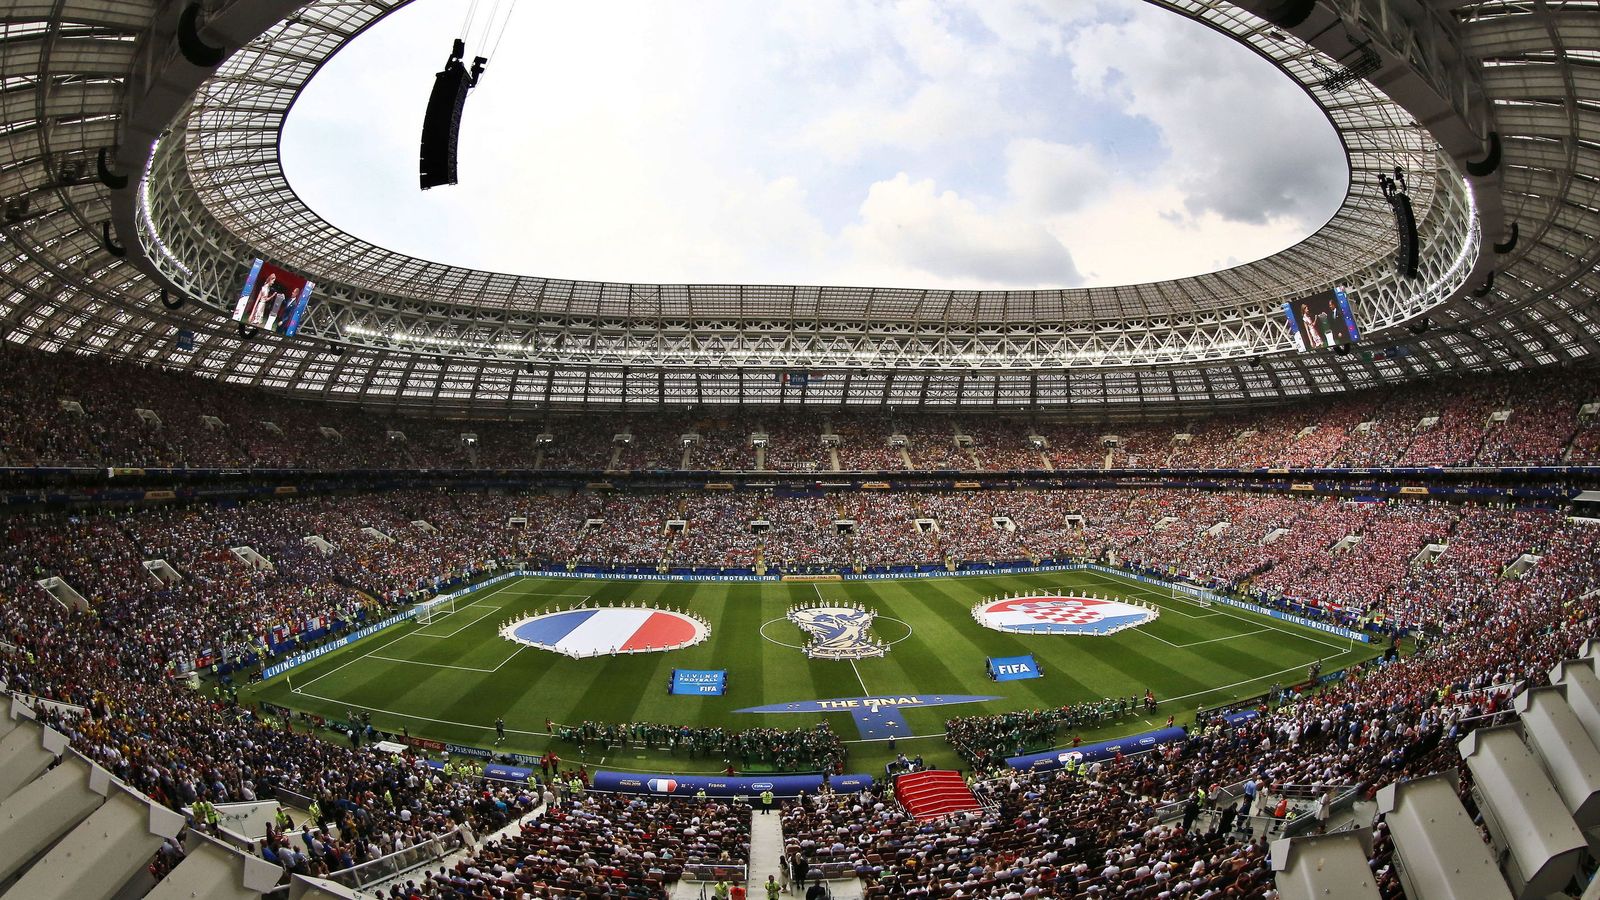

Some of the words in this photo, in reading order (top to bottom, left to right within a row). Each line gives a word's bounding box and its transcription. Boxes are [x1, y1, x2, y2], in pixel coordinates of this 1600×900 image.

[1091, 564, 1106, 572] LIVING
[1106, 566, 1129, 578] FOOTBALL
[476, 582, 488, 590] LIVING
[490, 574, 507, 584] FOOTBALL
[1144, 577, 1160, 586] LIVING
[1162, 581, 1188, 593] FOOTBALL
[1206, 593, 1224, 604] LIVING
[1227, 598, 1256, 611] FOOTBALL
[357, 623, 378, 638] LIVING
[380, 614, 406, 629] FOOTBALL
[1282, 612, 1305, 624] LIVING
[1308, 620, 1344, 636] FOOTBALL
[1350, 631, 1362, 640] FIFA
[267, 658, 295, 677] LIVING
[298, 644, 333, 664] FOOTBALL
[337, 639, 348, 648] FIFA
[998, 663, 1031, 675] FIFA
[817, 699, 860, 709] THE
[467, 747, 491, 757] WANDA
